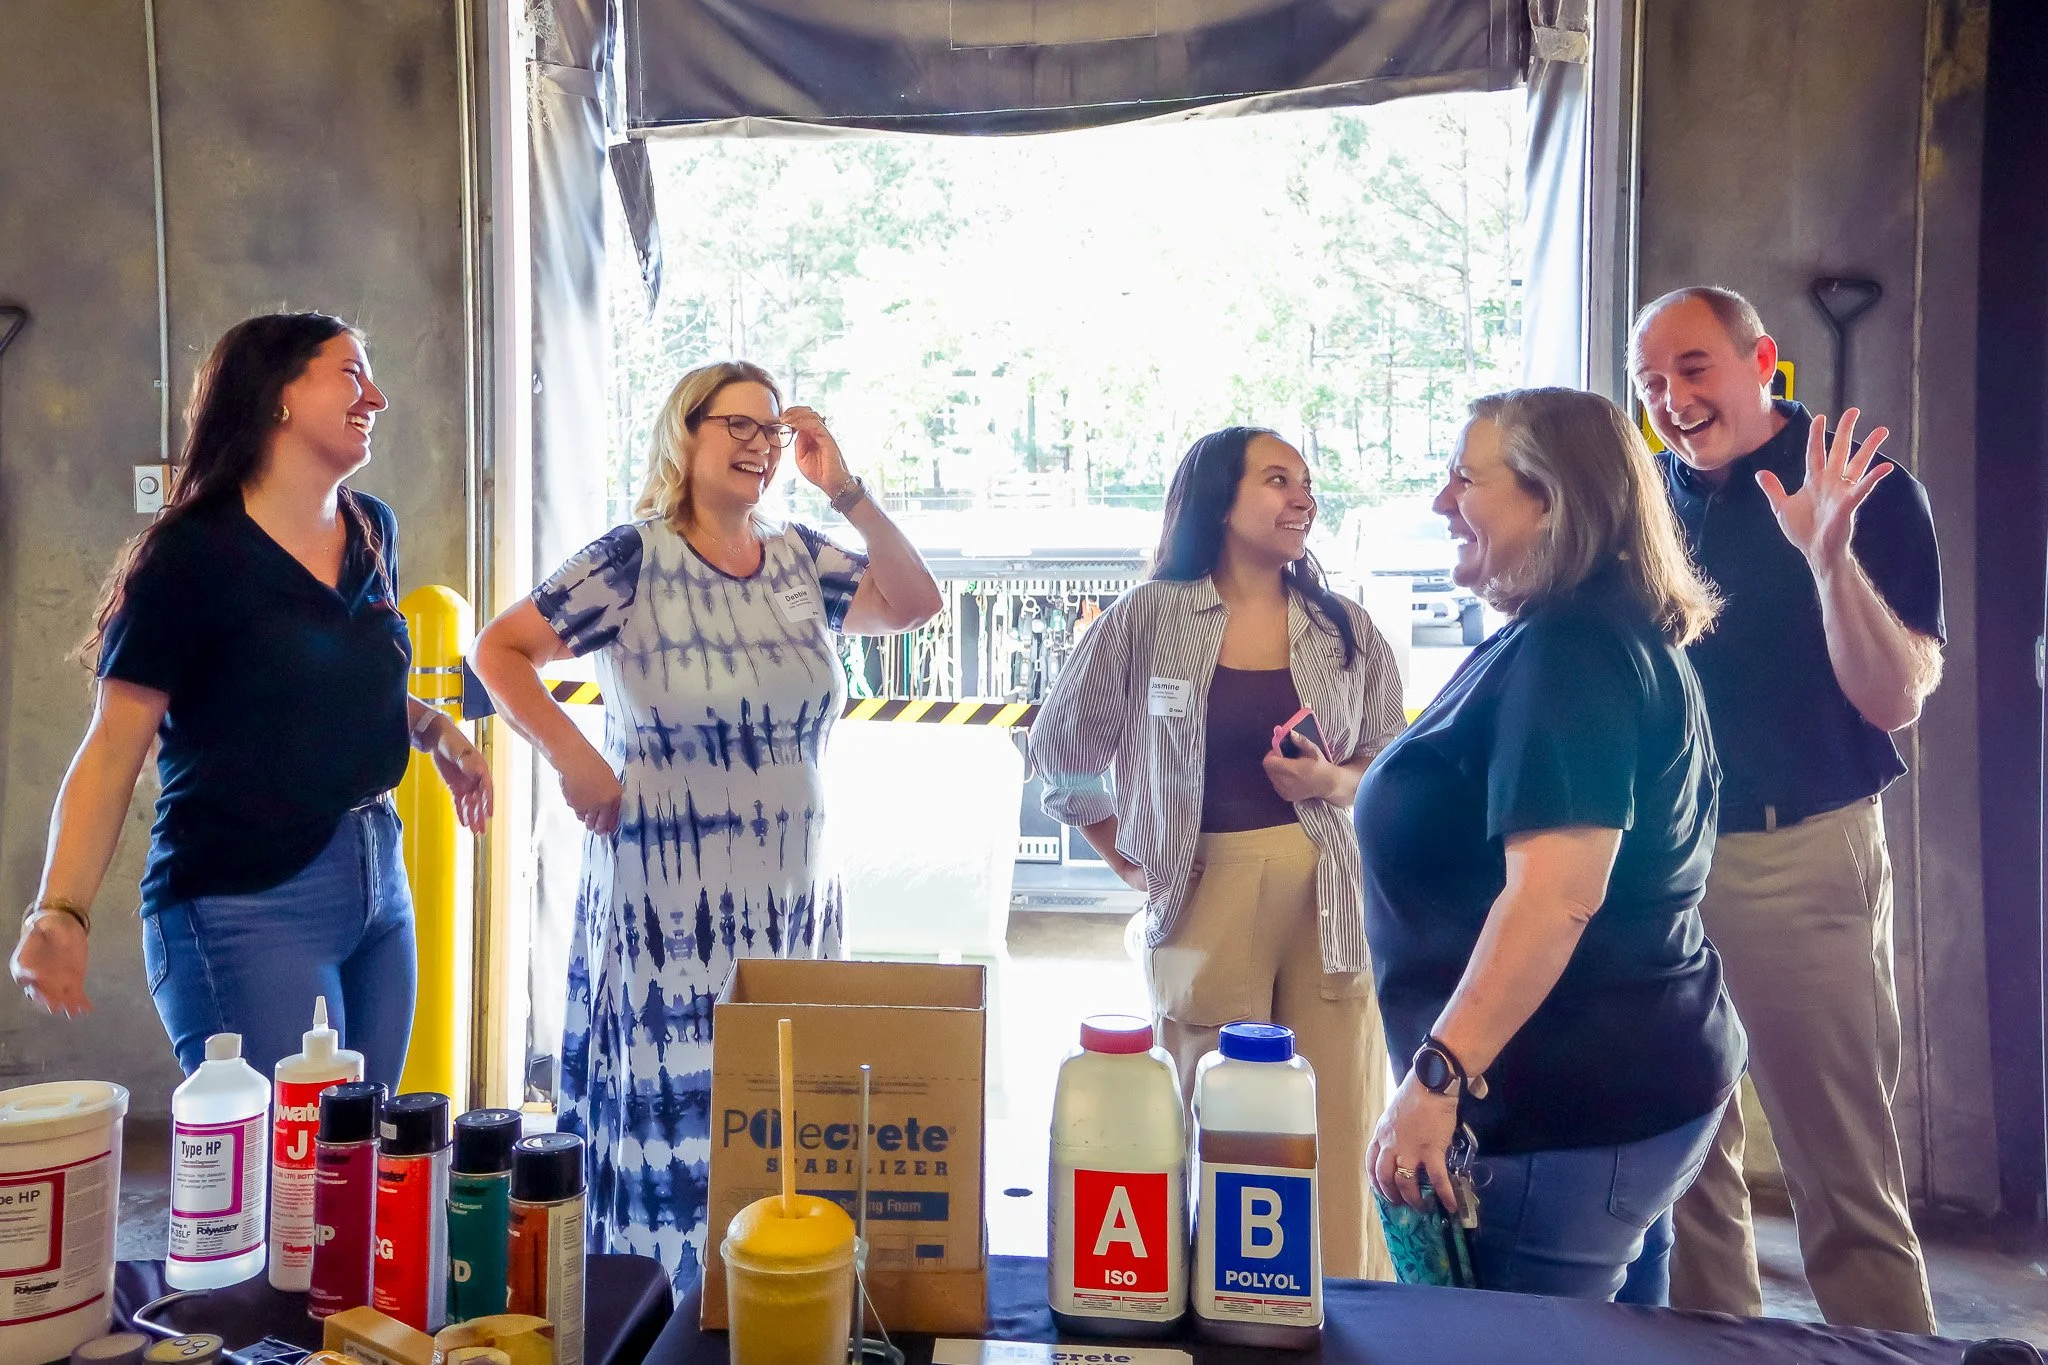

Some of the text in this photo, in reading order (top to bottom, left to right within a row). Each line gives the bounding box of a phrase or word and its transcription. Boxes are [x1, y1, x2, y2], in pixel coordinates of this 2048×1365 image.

[1151, 681, 1180, 691] Jasmine
[181, 1140, 222, 1158] Type HP
[286, 1129, 309, 1161] J
[766, 1157, 949, 1177] SABIIZER
[18, 1189, 41, 1204] HP
[887, 1198, 922, 1213] Foam
[196, 1223, 239, 1236] Polywater
[1092, 1185, 1149, 1258] A
[1240, 1186, 1284, 1259] B
[1104, 1269, 1138, 1286] ISO
[1225, 1270, 1301, 1291] POLYOL
